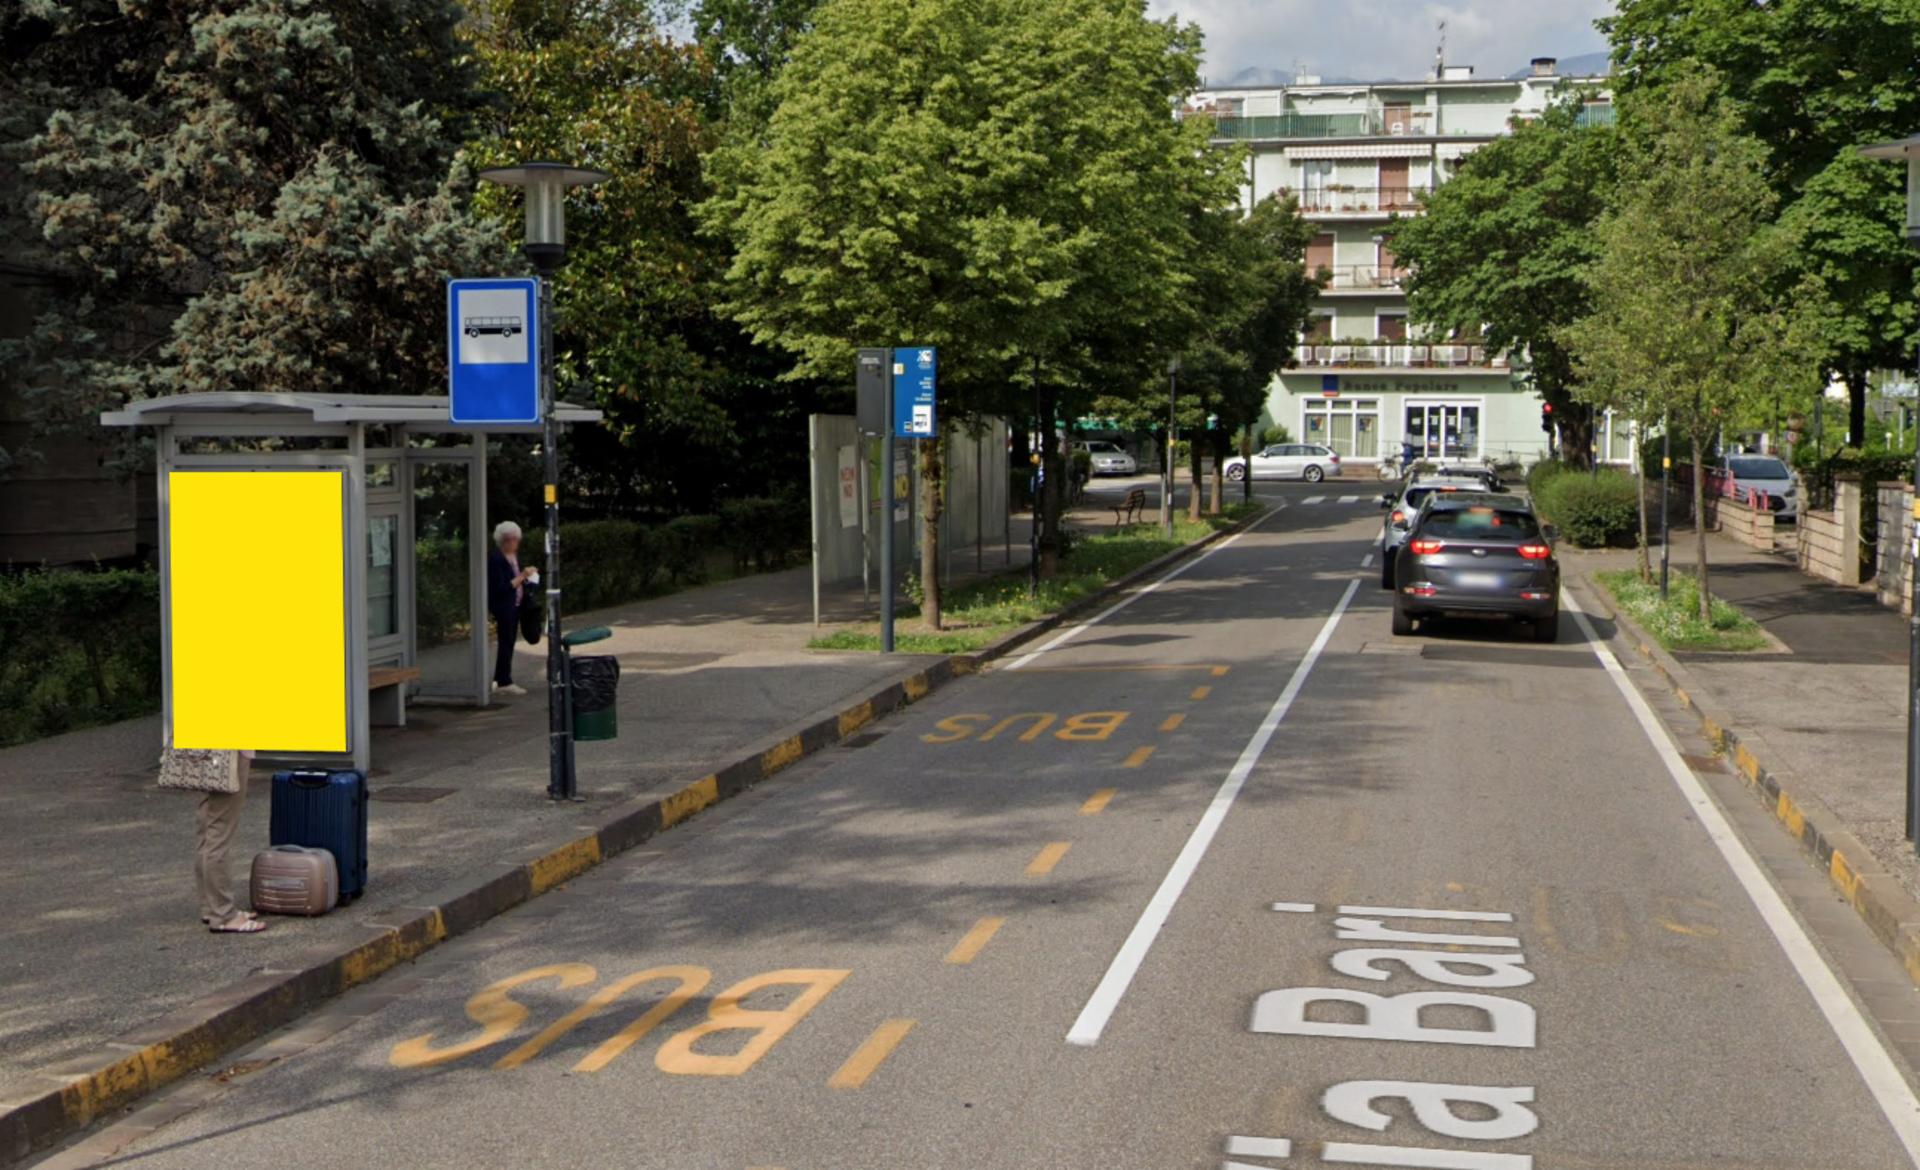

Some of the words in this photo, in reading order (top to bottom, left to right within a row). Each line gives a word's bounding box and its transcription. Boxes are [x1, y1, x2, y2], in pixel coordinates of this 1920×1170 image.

[1395, 380, 1458, 393] Popolare
[920, 710, 1131, 744] BUS
[389, 963, 852, 1077] BUS
